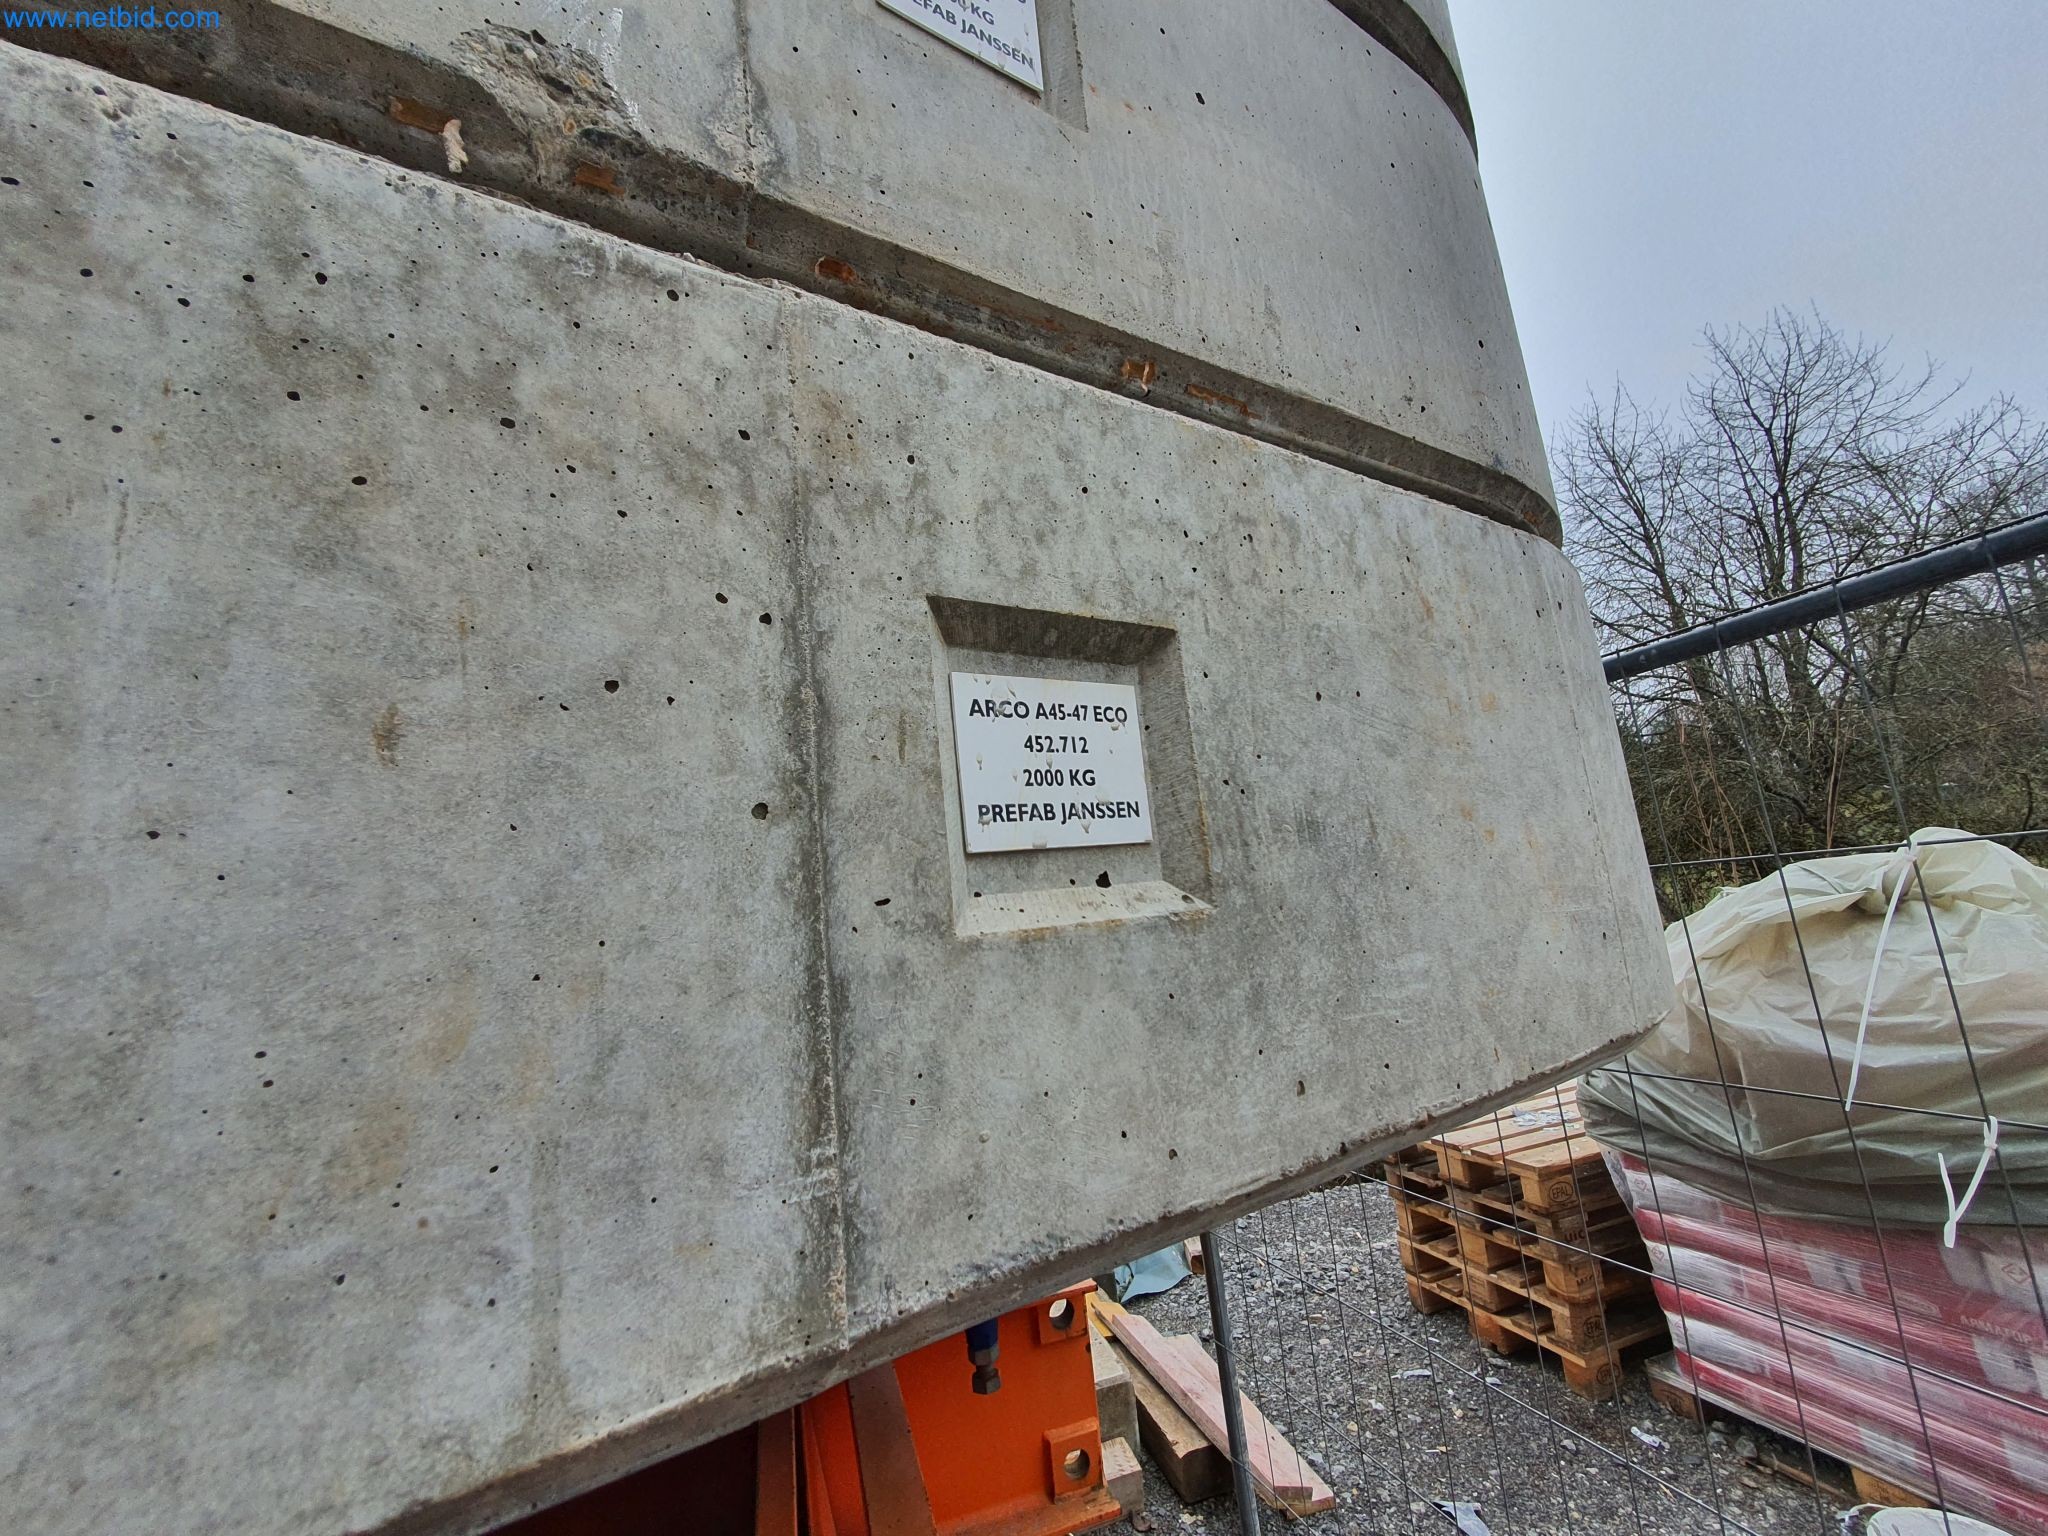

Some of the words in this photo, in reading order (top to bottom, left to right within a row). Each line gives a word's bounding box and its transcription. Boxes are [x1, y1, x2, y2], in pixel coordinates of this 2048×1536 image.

[971, 2, 994, 25] KG
[960, 19, 1034, 70] JANSSEN
[969, 699, 1030, 719] ARCO
[1035, 703, 1088, 721] A45-47
[1093, 706, 1128, 723] ECO
[1024, 735, 1089, 753] 452.712
[1023, 769, 1064, 787] 2000
[1070, 769, 1096, 787] KG
[978, 802, 1056, 825] PREFAB
[1061, 801, 1141, 824] JANSSEN
[1551, 1185, 1572, 1200] EPAL
